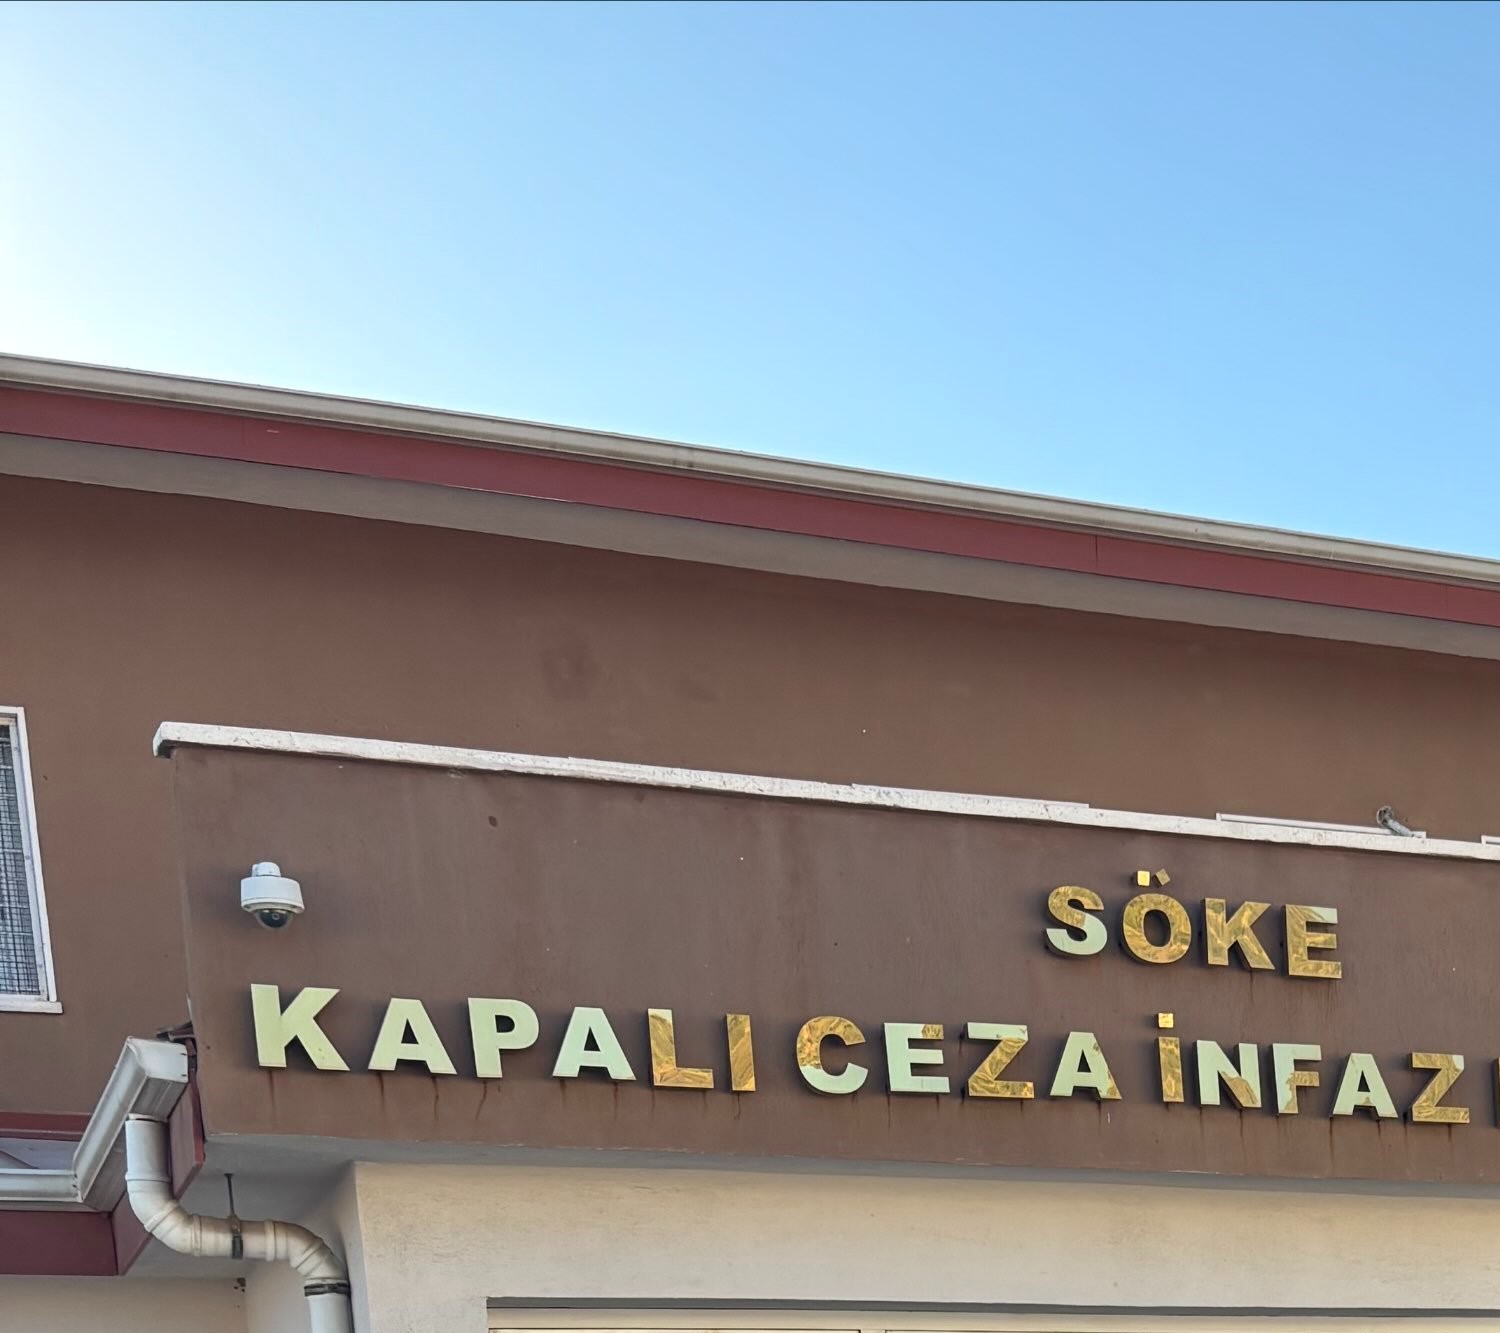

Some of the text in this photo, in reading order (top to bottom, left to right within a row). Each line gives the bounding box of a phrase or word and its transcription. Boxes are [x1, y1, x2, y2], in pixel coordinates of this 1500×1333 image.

[1045, 870, 1343, 980] SÖKE
[250, 982, 757, 1094] KAPALI
[796, 1015, 1123, 1101] CEZA
[1156, 1012, 1470, 1126] İNFAZ
